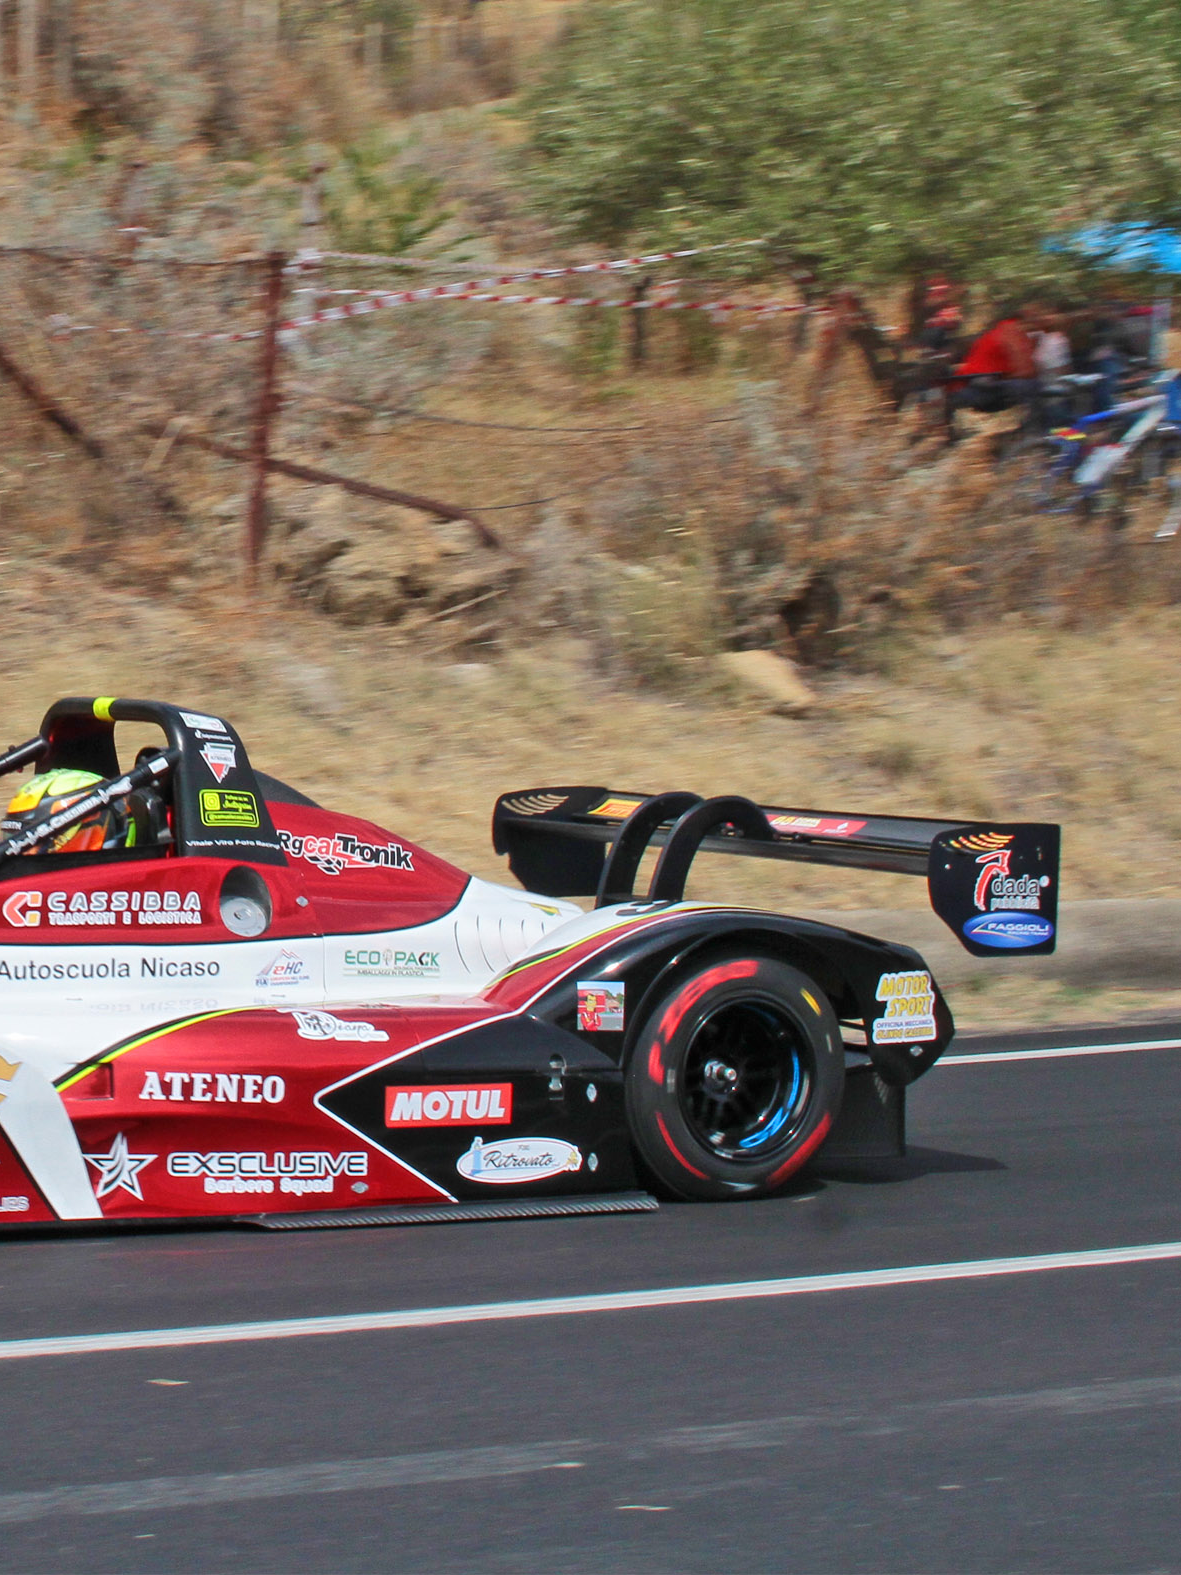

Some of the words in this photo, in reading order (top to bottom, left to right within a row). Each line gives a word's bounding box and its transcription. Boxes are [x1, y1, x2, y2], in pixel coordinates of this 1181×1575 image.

[991, 874, 1040, 896] dada
[47, 891, 202, 911] CASSIBBA
[48, 912, 117, 925] TRASPORTI
[122, 911, 132, 924] E
[138, 911, 202, 924] LOGISTICA
[987, 923, 1049, 931] FAGGIOLI
[140, 957, 221, 978] Nicaso
[344, 950, 381, 965] ECO
[394, 952, 441, 966] PACK
[879, 975, 929, 997] MOTOR
[887, 995, 932, 1017] SPORT
[139, 1071, 286, 1103] ATENEO
[390, 1090, 505, 1121] MOTUL
[168, 1153, 368, 1176] EXSCLUSIVE
[483, 1150, 554, 1168] Ritrovato
[204, 1176, 274, 1193] Barbers
[279, 1176, 334, 1196] Squad
